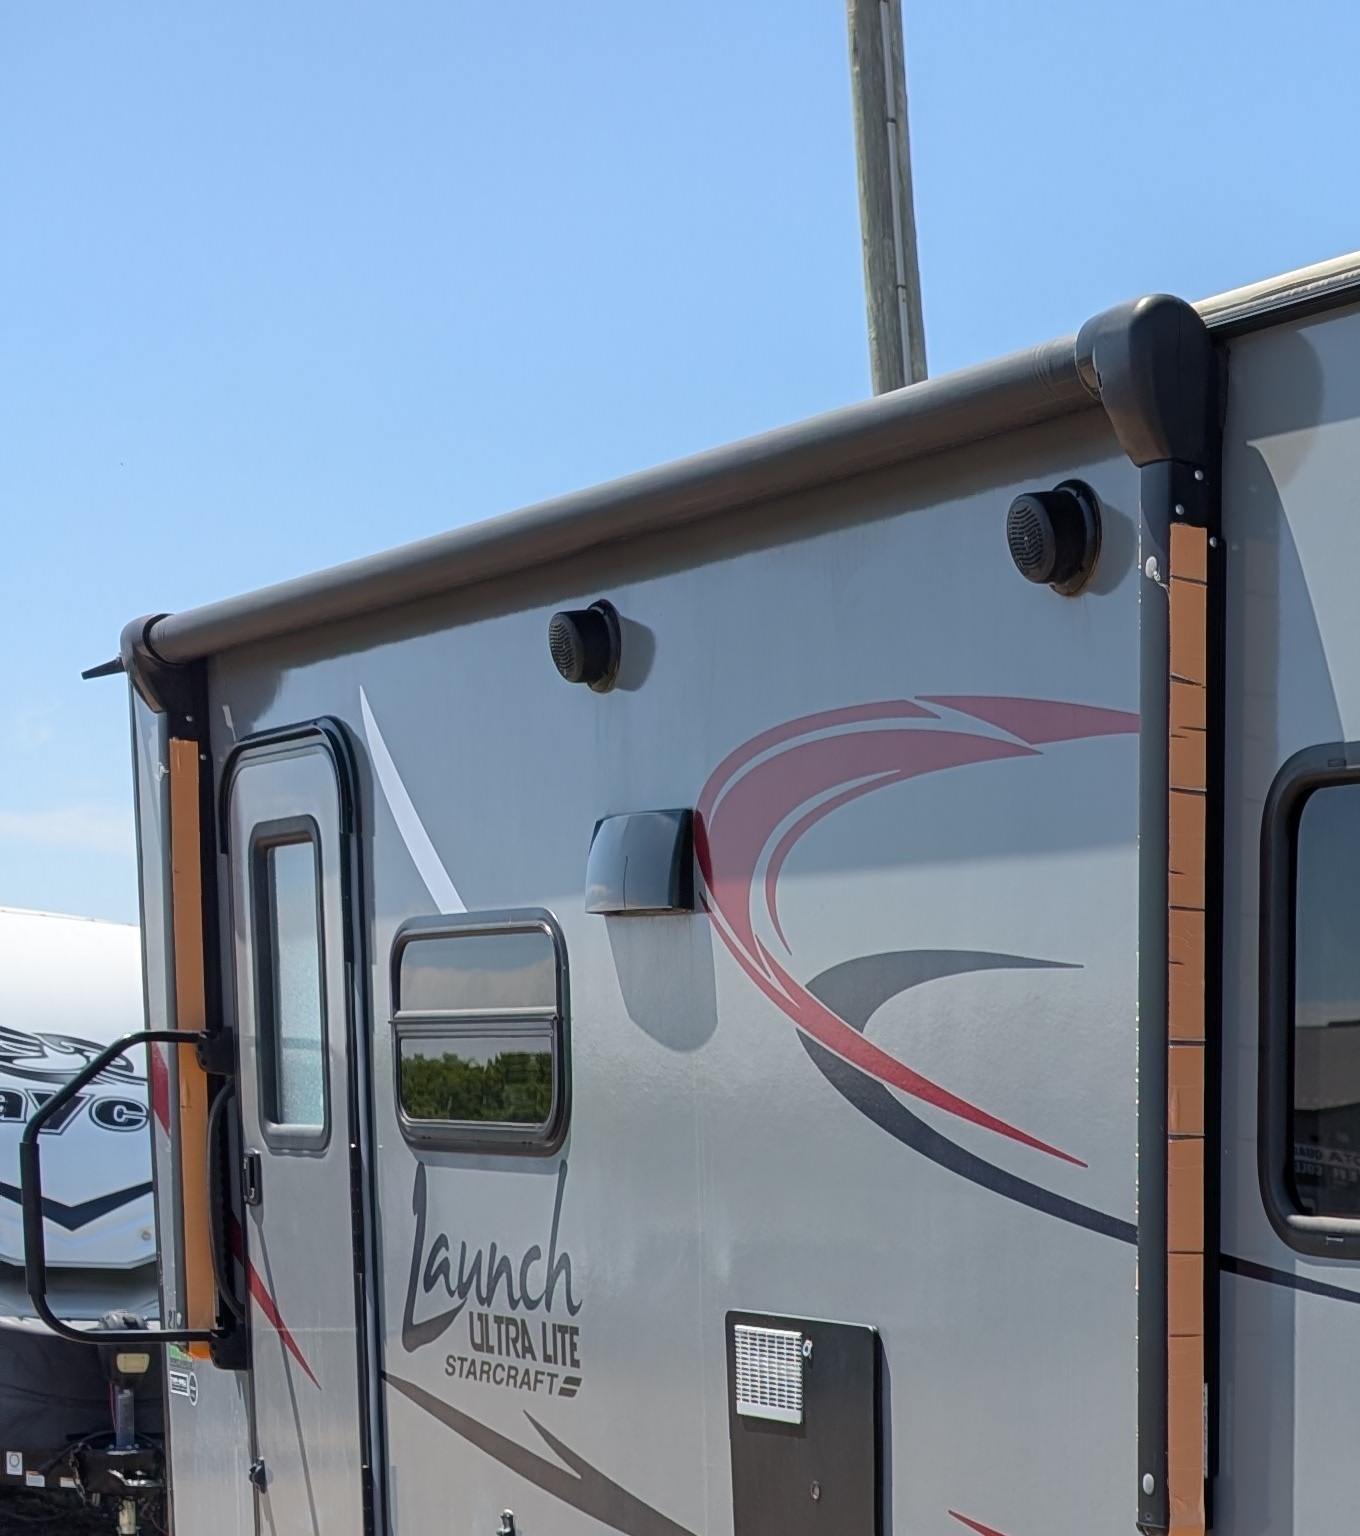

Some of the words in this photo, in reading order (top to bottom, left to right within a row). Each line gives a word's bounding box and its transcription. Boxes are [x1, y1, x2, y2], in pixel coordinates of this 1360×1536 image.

[402, 1159, 583, 1353] Launch
[469, 1311, 537, 1361] ULTRA
[542, 1321, 581, 1369] LITE
[444, 1354, 559, 1396] STARCRAFT
